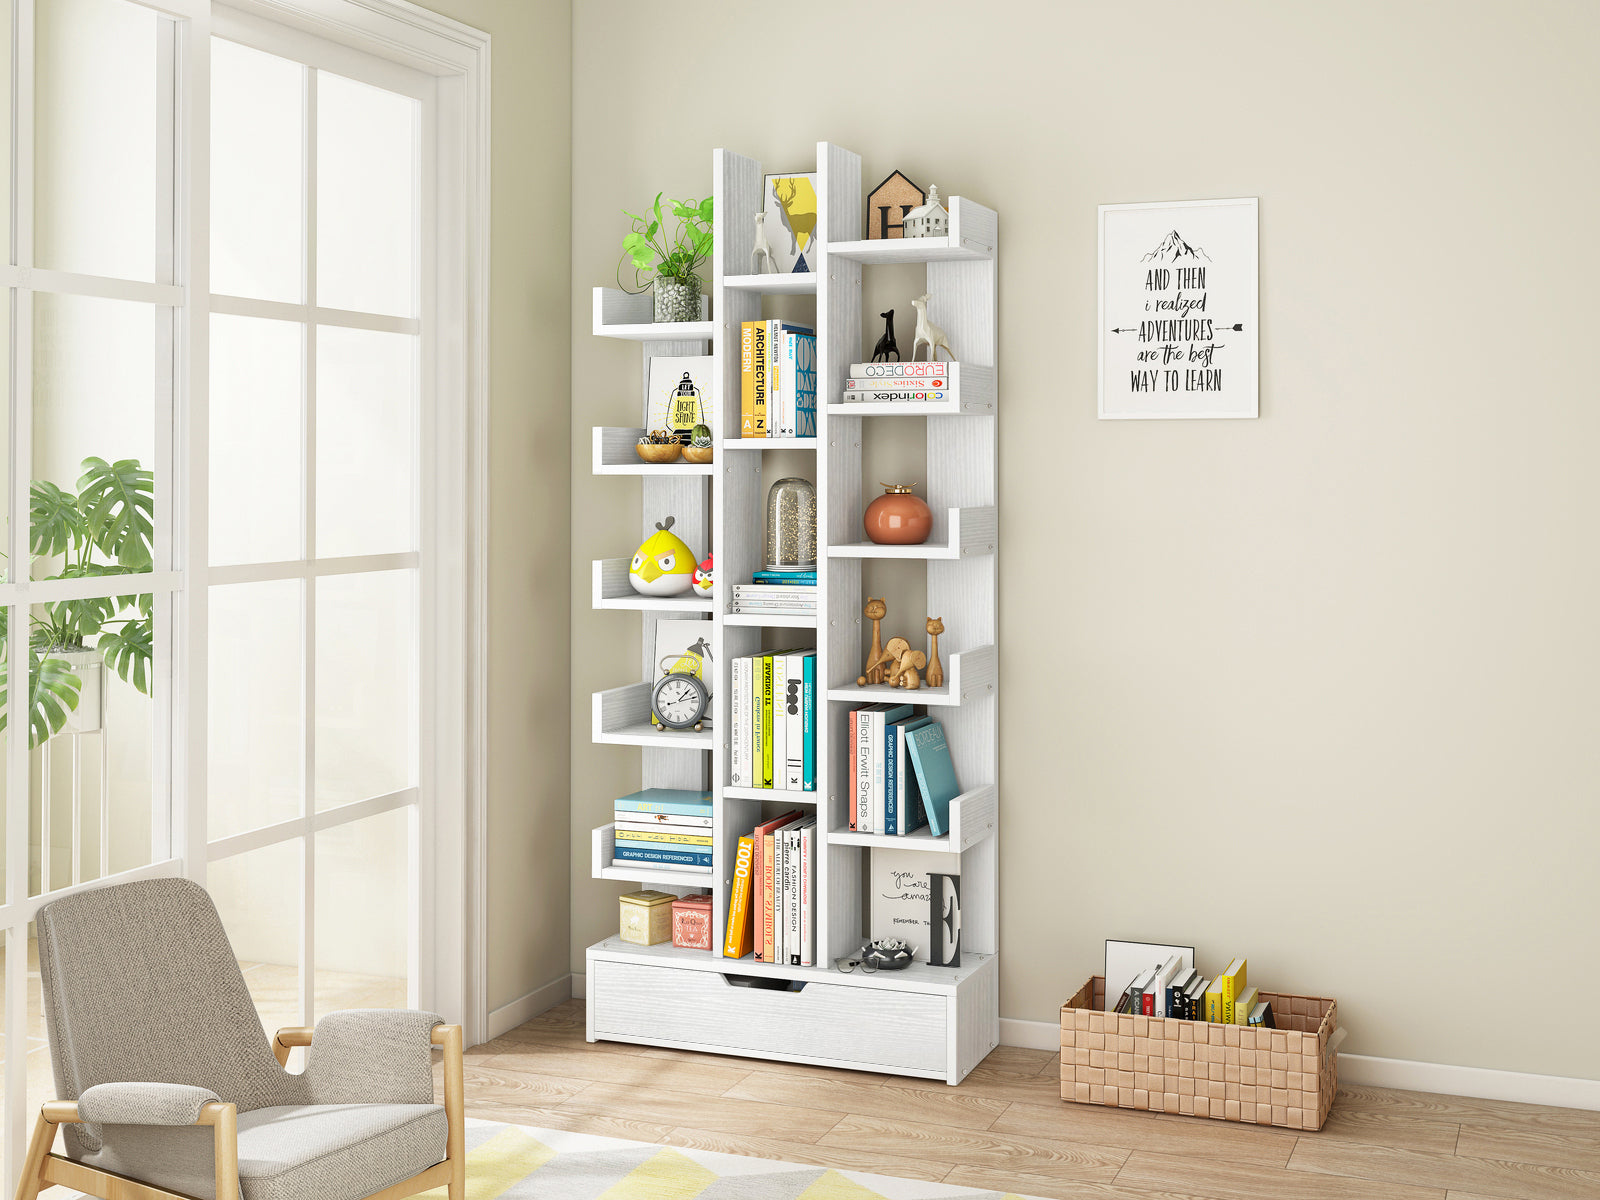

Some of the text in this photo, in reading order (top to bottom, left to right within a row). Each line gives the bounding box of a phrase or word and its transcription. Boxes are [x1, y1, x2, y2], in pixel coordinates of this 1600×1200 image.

[1145, 267, 1206, 291] AND THEN
[1145, 292, 1206, 318] i realized
[1138, 319, 1213, 342] ADVENTURES
[743, 328, 752, 372] MODERN
[1137, 344, 1226, 367] are the best
[756, 328, 764, 405] ARCHITECTURE
[1131, 369, 1222, 392] WAY TO LEARN
[676, 400, 695, 412] LIGHT
[874, 392, 943, 401] colorindex
[675, 412, 695, 426] SHINE
[744, 420, 752, 428] A
[757, 420, 764, 428] Z
[860, 714, 870, 817] Elliott Erwitt Snaps
[637, 803, 652, 811] ART
[891, 871, 913, 889] you
[904, 881, 930, 890] are
[926, 872, 960, 968] E
